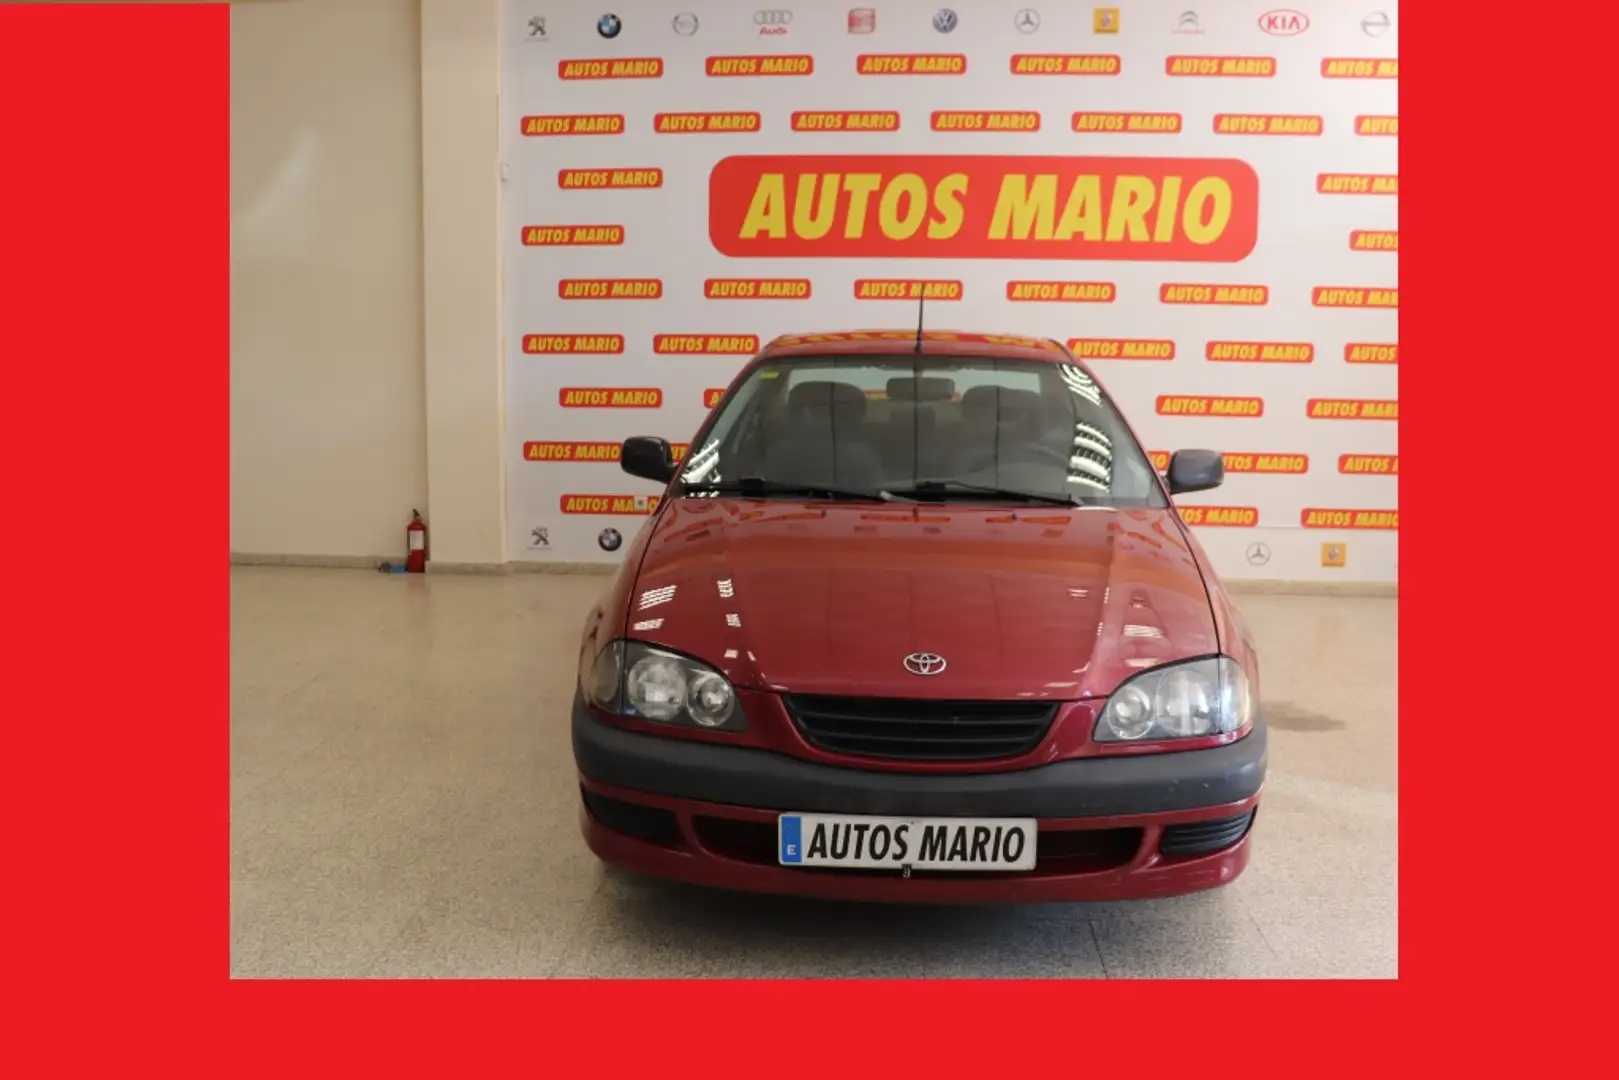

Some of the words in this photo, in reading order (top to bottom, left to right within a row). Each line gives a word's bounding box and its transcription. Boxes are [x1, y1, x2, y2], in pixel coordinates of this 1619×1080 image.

[1267, 15, 1300, 30] KIA
[564, 61, 610, 76] AUTOS
[611, 61, 659, 76] MARIO
[711, 58, 758, 74] AUTOS
[760, 58, 809, 74] MARIO
[863, 57, 909, 73] AUTOS
[912, 57, 963, 73] MARIO
[1016, 56, 1063, 72] AUTOS
[1067, 56, 1117, 72] MARIO
[1171, 58, 1219, 75] AUTOS
[1222, 58, 1272, 75] MARIO
[1327, 61, 1373, 76] AUTOS
[526, 117, 571, 133] AUTOS
[573, 117, 621, 133] MARIO
[660, 115, 706, 131] AUTOS
[708, 115, 757, 131] MARIO
[797, 113, 844, 129] AUTOS
[846, 113, 896, 129] MARIO
[937, 113, 984, 130] AUTOS
[986, 113, 1037, 130] MARIO
[1077, 115, 1125, 131] AUTOS
[1128, 115, 1179, 131] MARIO
[1219, 117, 1266, 134] AUTOS
[1269, 117, 1319, 134] MARIO
[1360, 118, 1398, 134] AUTO
[564, 171, 610, 186] AUTOS
[611, 171, 659, 186] MARIO
[1322, 176, 1369, 192] AUTOS
[739, 172, 970, 240] AUTOS
[987, 174, 1233, 244] MARIO
[527, 227, 571, 243] AUTOS
[573, 227, 620, 243] MARIO
[564, 281, 610, 297] AUTOS
[611, 281, 658, 297] MARIO
[710, 281, 756, 297] AUTOS
[759, 281, 807, 297] MARIO
[860, 282, 907, 298] AUTOS
[909, 282, 959, 298] MARIO
[1012, 283, 1059, 301] AUTOS
[1062, 283, 1112, 301] MARIO
[1165, 286, 1213, 304] AUTOS
[1215, 286, 1265, 304] MARIO
[1317, 288, 1364, 306] AUTOS
[527, 336, 572, 351] AUTOS
[574, 336, 620, 351] MARIO
[659, 337, 706, 352] AUTOS
[708, 337, 755, 352] MARIO
[1072, 342, 1118, 358] AUTOS
[1121, 342, 1171, 358] MARIO
[1211, 343, 1259, 361] AUTOS
[1261, 343, 1310, 361] MARIO
[565, 391, 610, 405] AUTOS
[612, 391, 658, 405] MARIO
[1160, 398, 1208, 416] AUTOS
[1210, 398, 1260, 416] MARIO
[1311, 401, 1359, 418] AUTOS
[529, 444, 573, 459] AUTOS
[575, 444, 621, 459] MARIO
[1255, 455, 1305, 472] MARIO
[1344, 457, 1389, 473] AUTOS
[566, 497, 610, 511] AUTOS
[1205, 508, 1256, 525] MARIO
[1307, 510, 1352, 527] AUTOS
[787, 845, 796, 856] E
[807, 823, 909, 861] AUTOS
[918, 826, 1025, 863] MARIO
